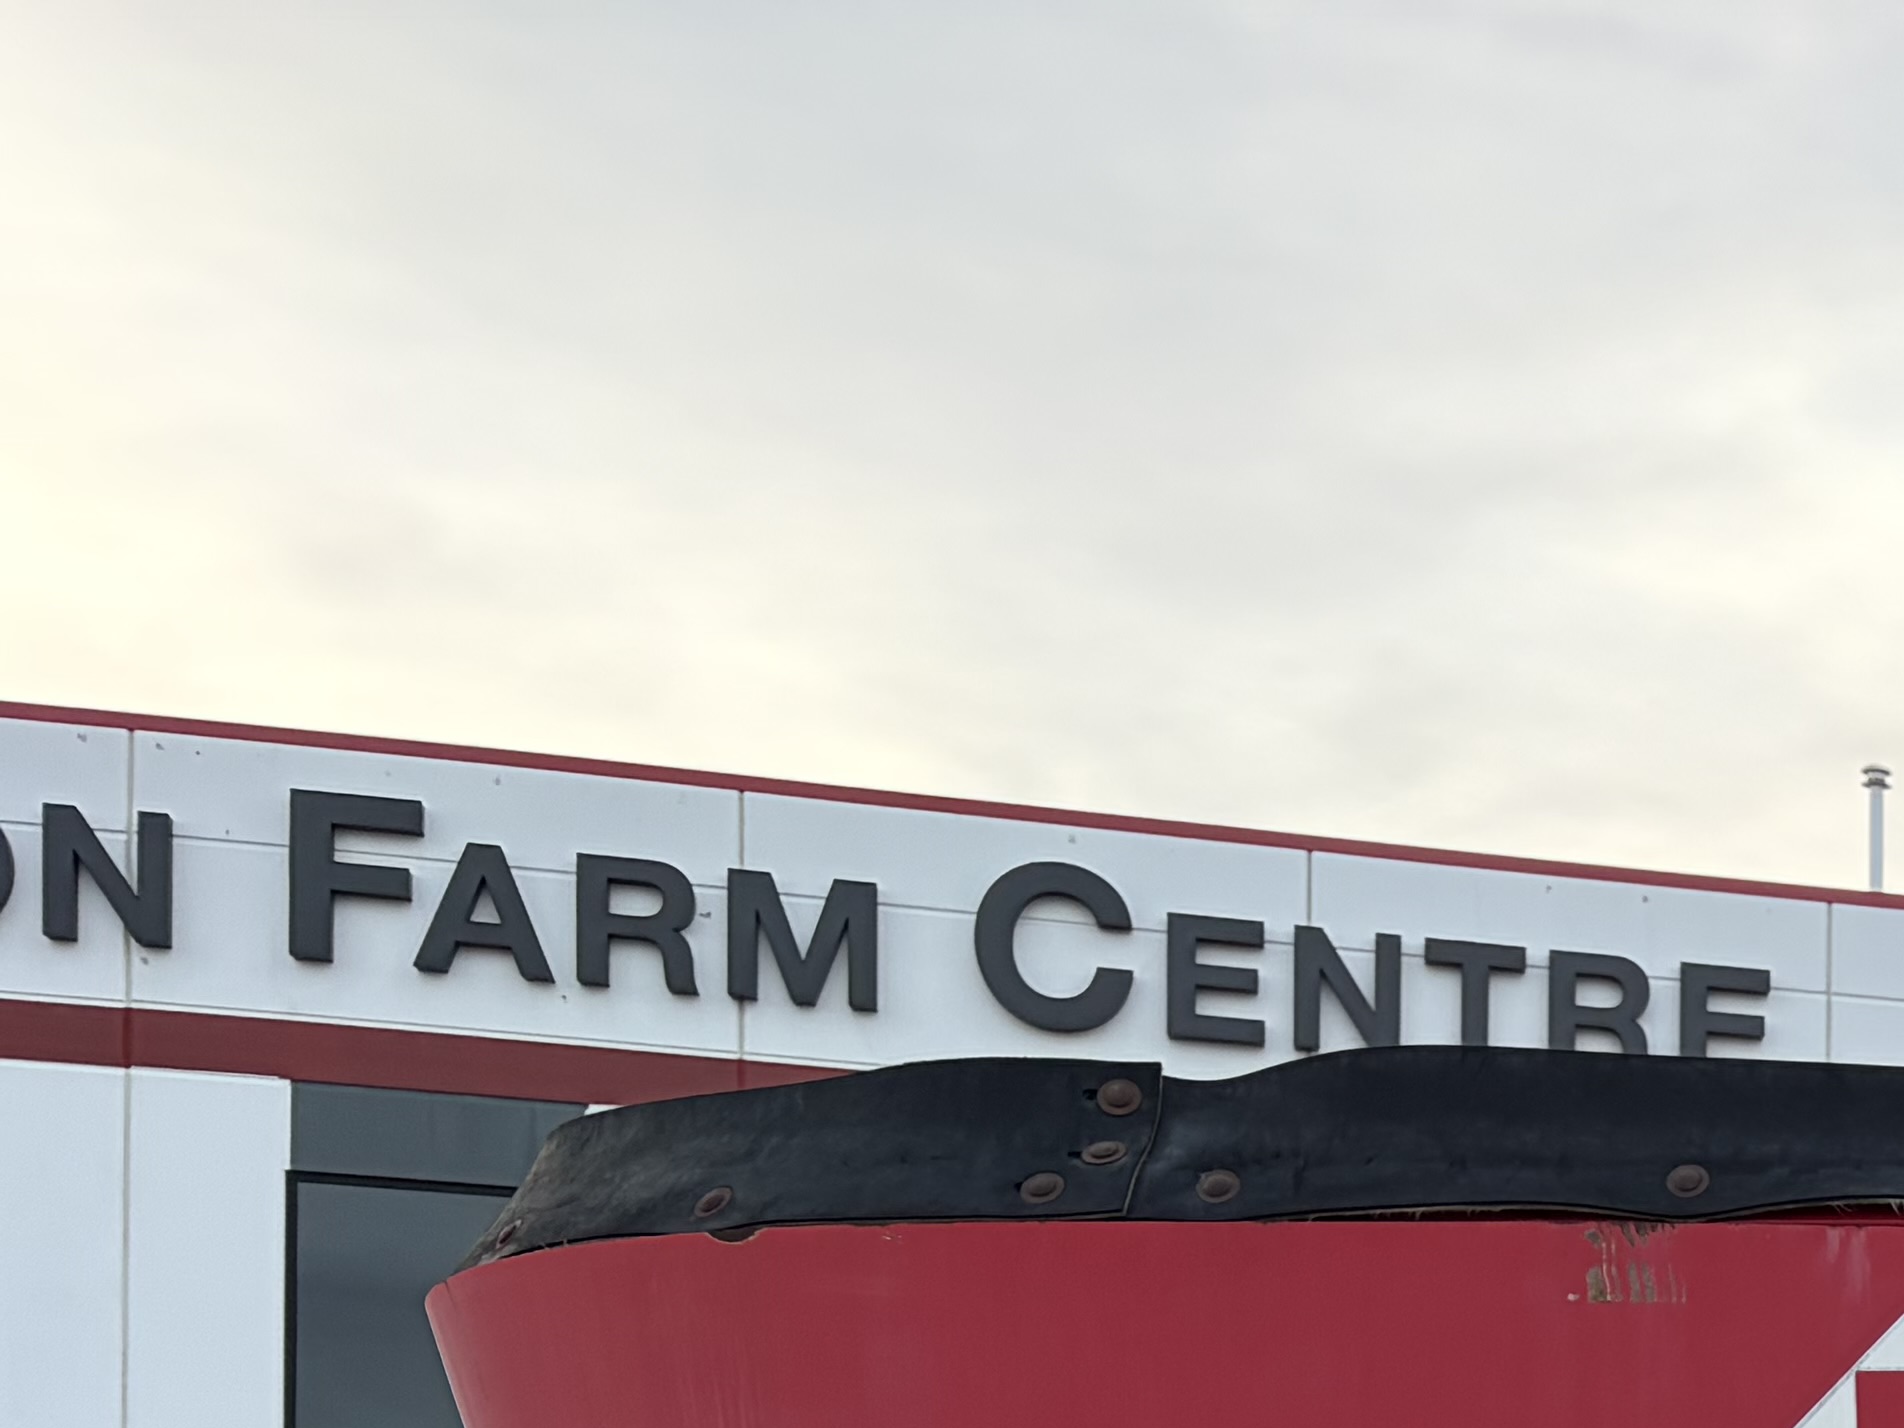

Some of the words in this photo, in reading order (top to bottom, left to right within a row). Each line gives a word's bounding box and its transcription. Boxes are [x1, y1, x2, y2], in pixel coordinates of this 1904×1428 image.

[0, 803, 174, 950] N
[290, 788, 880, 1014] FARM
[974, 861, 1771, 1060] CENTRE
